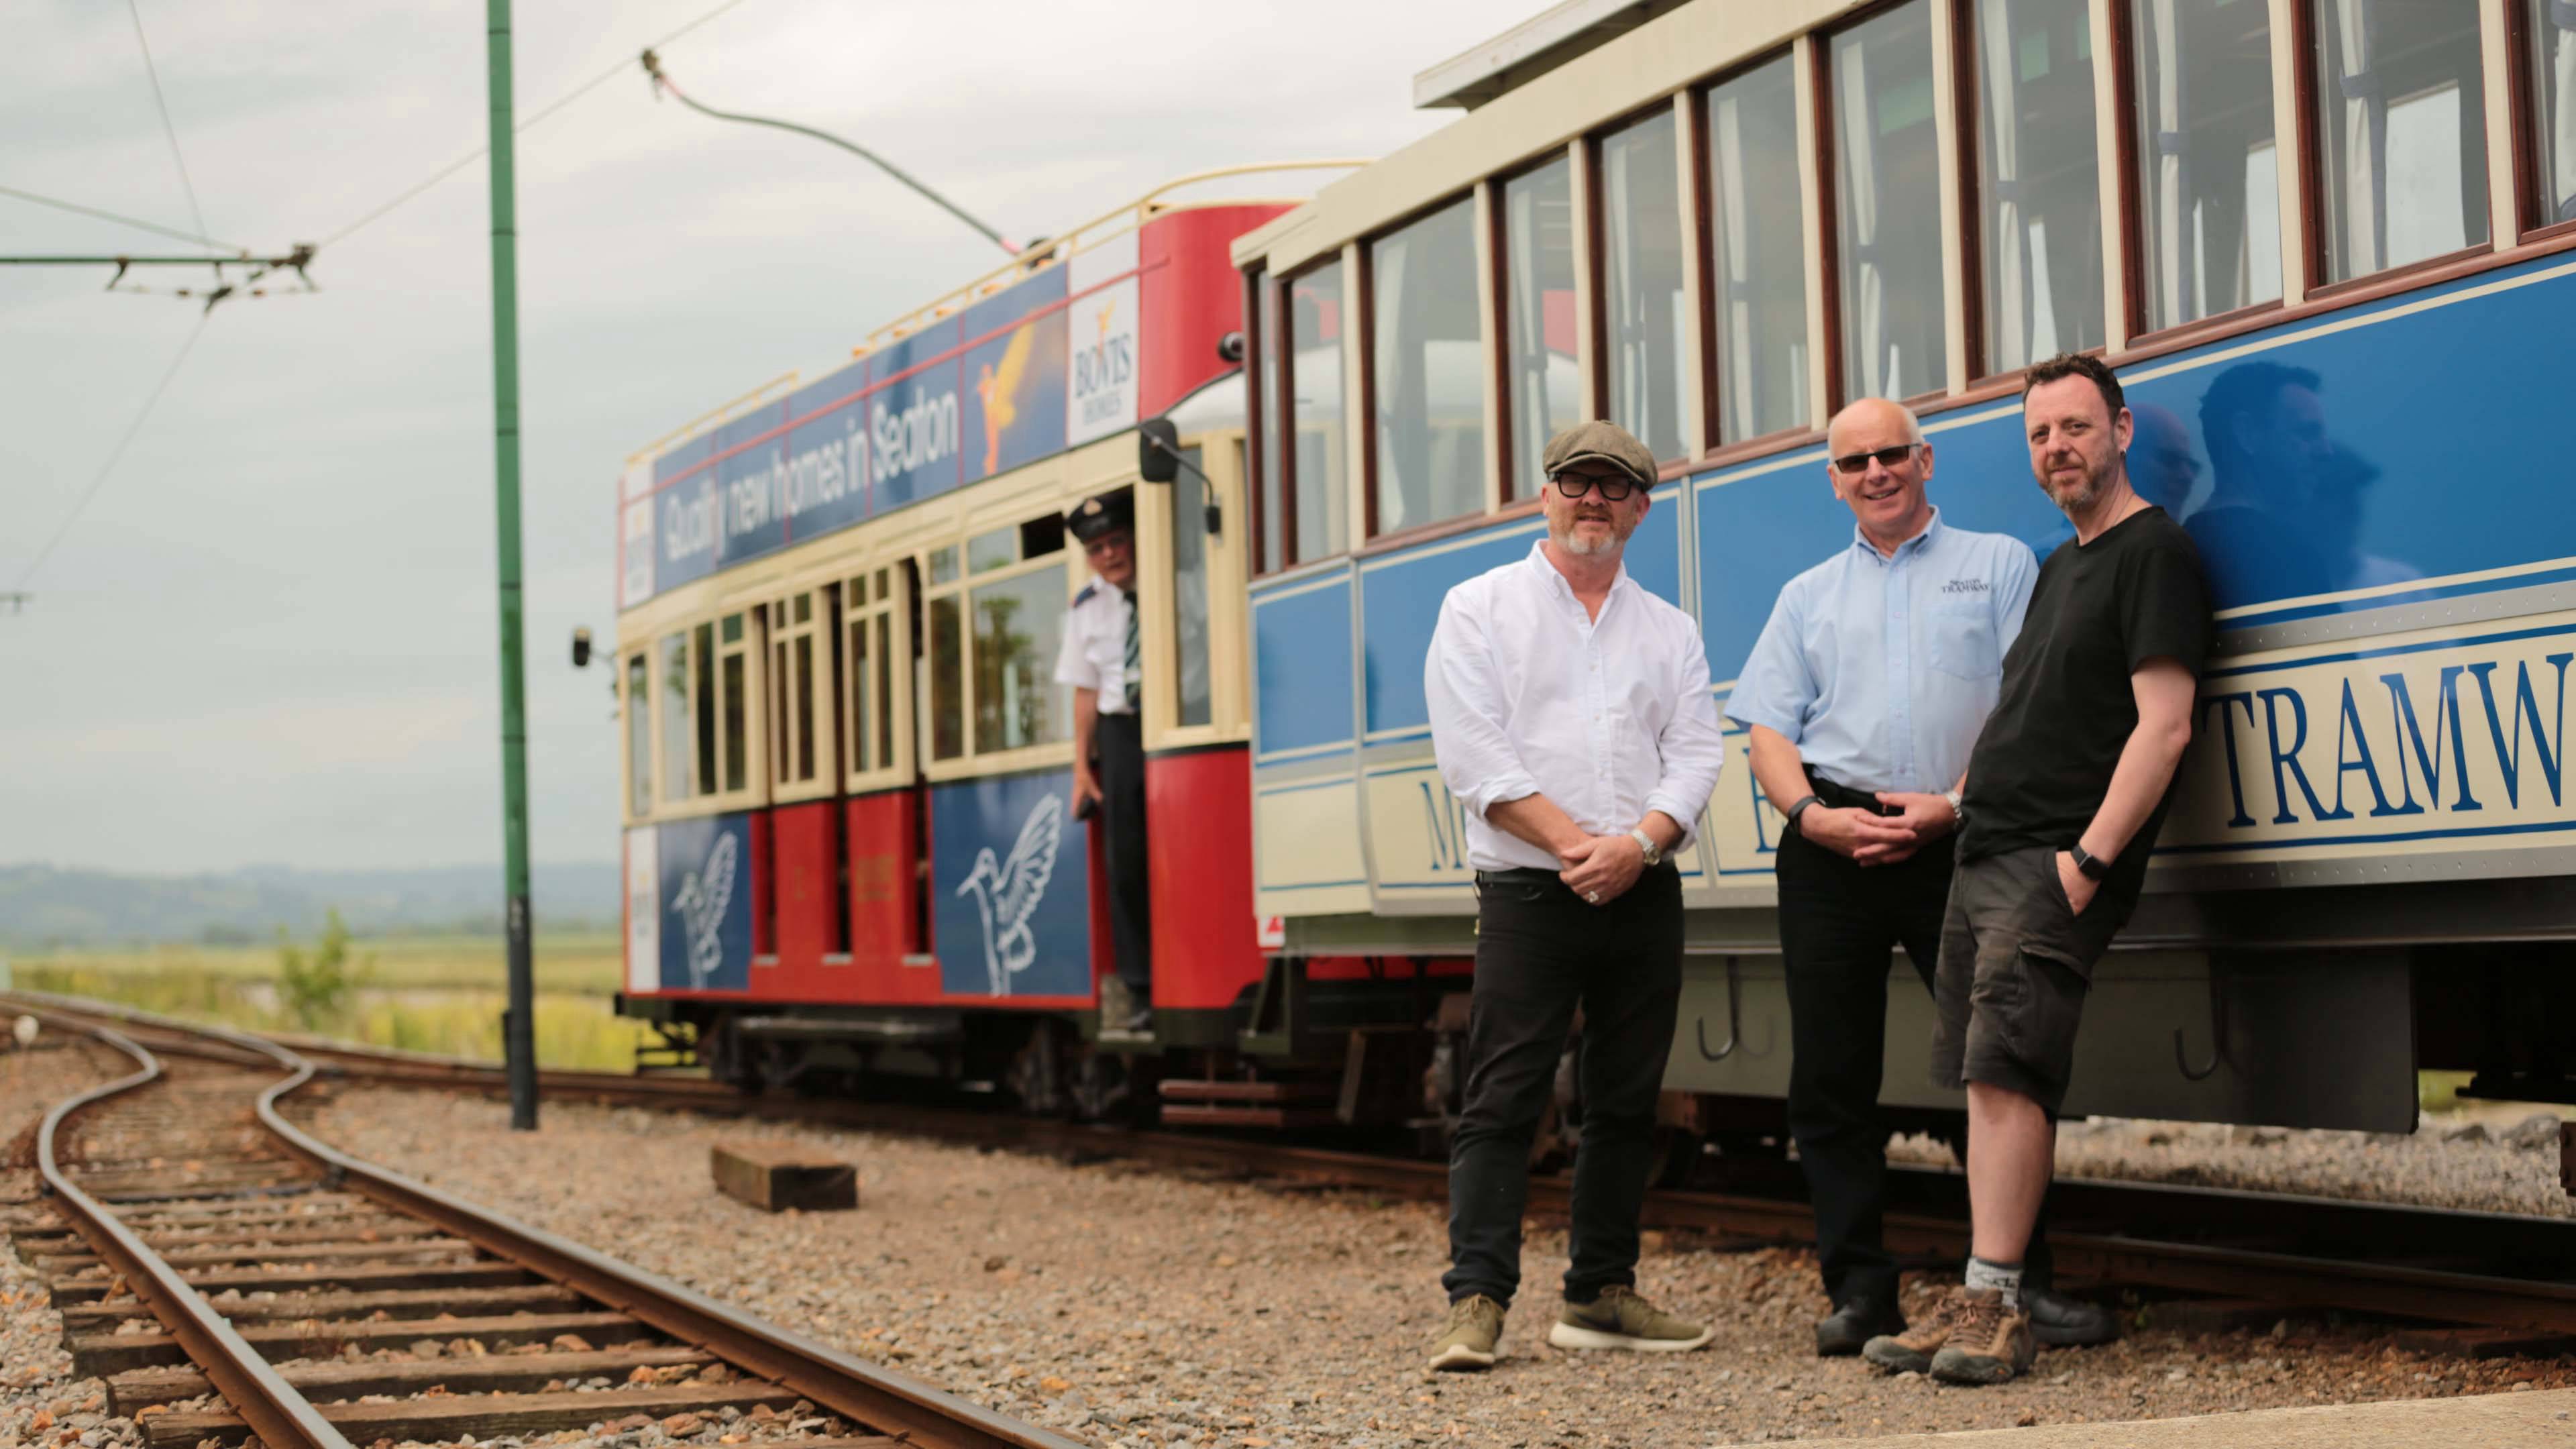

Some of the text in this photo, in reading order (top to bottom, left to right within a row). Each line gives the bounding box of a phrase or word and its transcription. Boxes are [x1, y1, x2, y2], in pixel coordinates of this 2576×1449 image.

[729, 471, 770, 535] new
[771, 447, 845, 518] homes
[846, 417, 869, 493] in
[872, 385, 959, 483] Seaton
